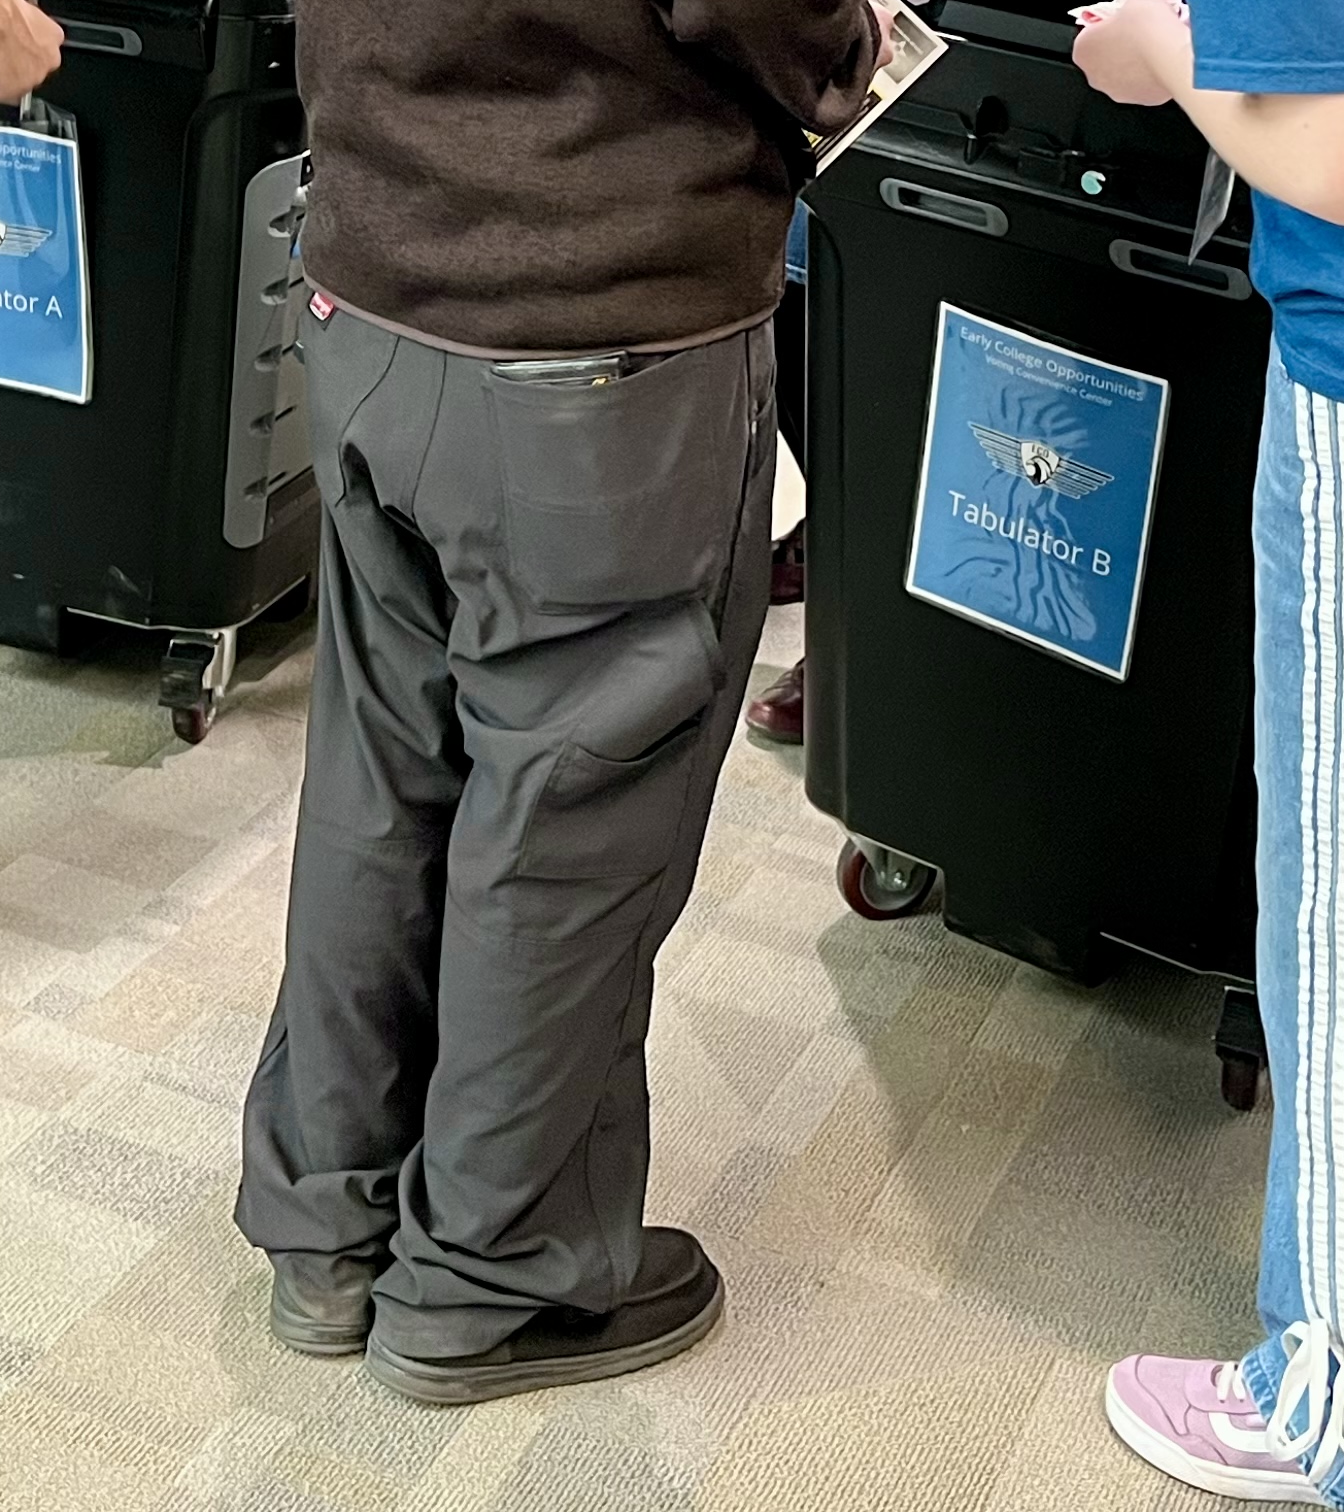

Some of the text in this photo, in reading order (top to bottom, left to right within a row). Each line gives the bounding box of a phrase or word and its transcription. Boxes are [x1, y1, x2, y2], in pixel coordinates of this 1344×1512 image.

[45, 296, 64, 320] A
[960, 326, 1145, 402] Early College Opportunities
[1078, 388, 1113, 407] Center
[947, 489, 1112, 577] Tabulator B
